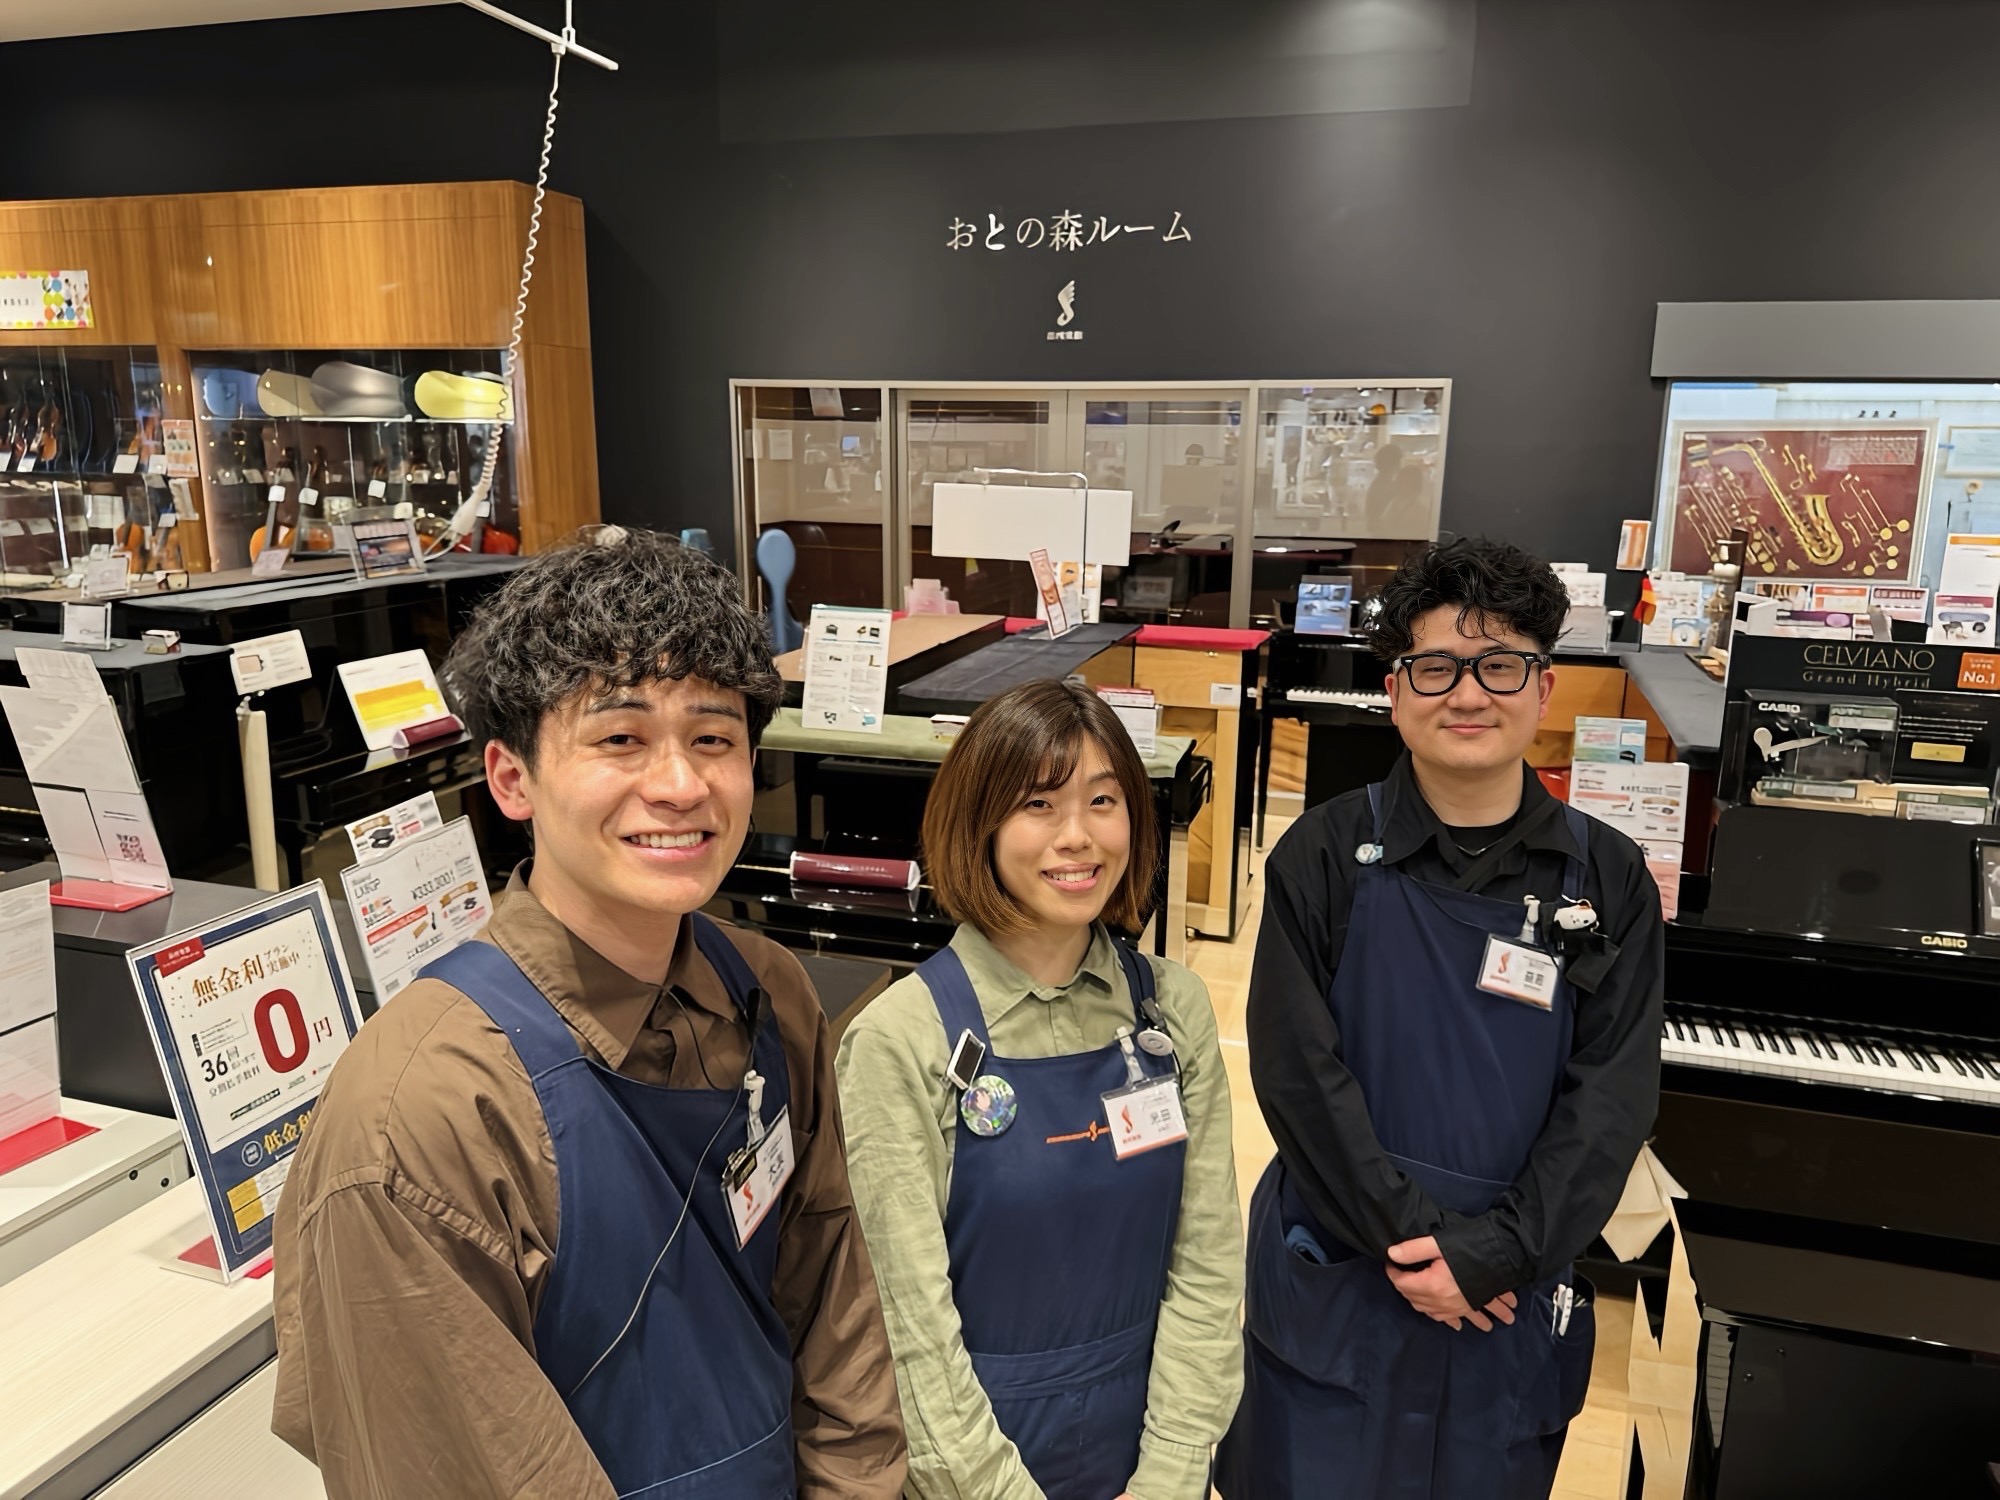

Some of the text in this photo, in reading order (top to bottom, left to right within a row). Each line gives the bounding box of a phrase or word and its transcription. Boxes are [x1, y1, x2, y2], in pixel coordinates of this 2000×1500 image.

[946, 208, 1193, 252] おとの森ルーム
[1803, 644, 1936, 671] CELVIANO
[1802, 671, 1931, 689] Grand Hybrid
[1963, 671, 1995, 685] No.1
[1758, 702, 1801, 714] CASIO
[1921, 935, 1968, 949] CASIO
[192, 954, 265, 1008] 無金利
